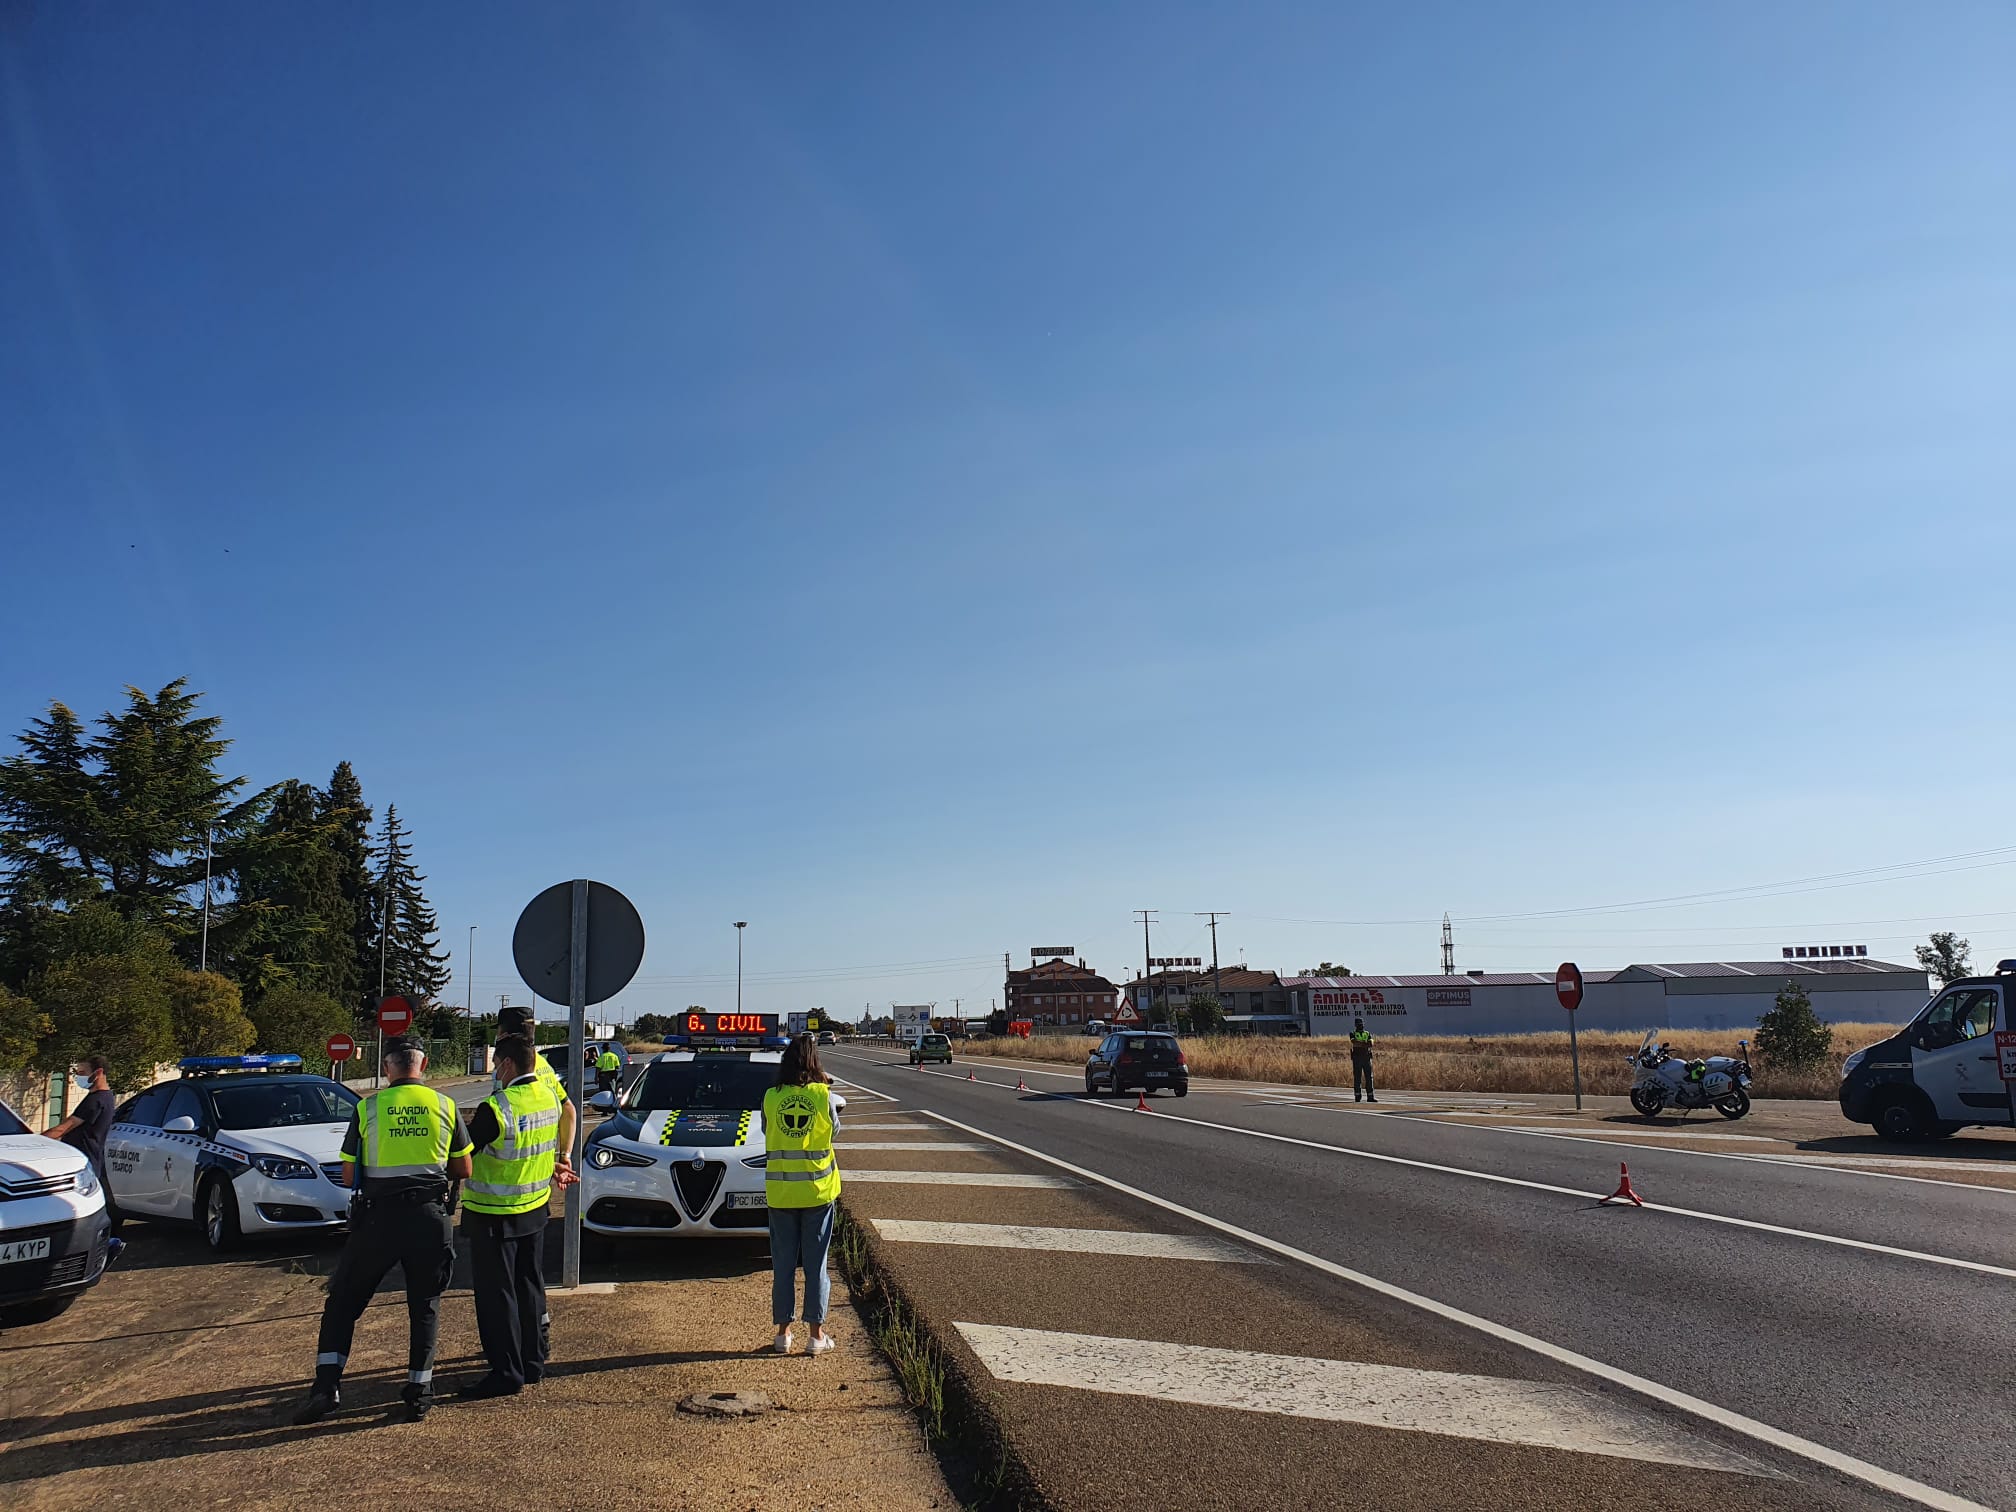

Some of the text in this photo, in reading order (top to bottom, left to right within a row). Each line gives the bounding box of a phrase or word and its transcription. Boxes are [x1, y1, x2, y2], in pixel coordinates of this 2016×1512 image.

[1428, 991, 1470, 1000] OPTIMUS
[1364, 1003, 1405, 1011] SUMINISTROS
[1367, 1009, 1408, 1017] MAQUINARIA
[688, 1015, 767, 1031] G. CIVIL
[387, 1106, 429, 1115] GUARDIA
[397, 1116, 419, 1125] CIVIL
[17, 1241, 46, 1259] KYP
